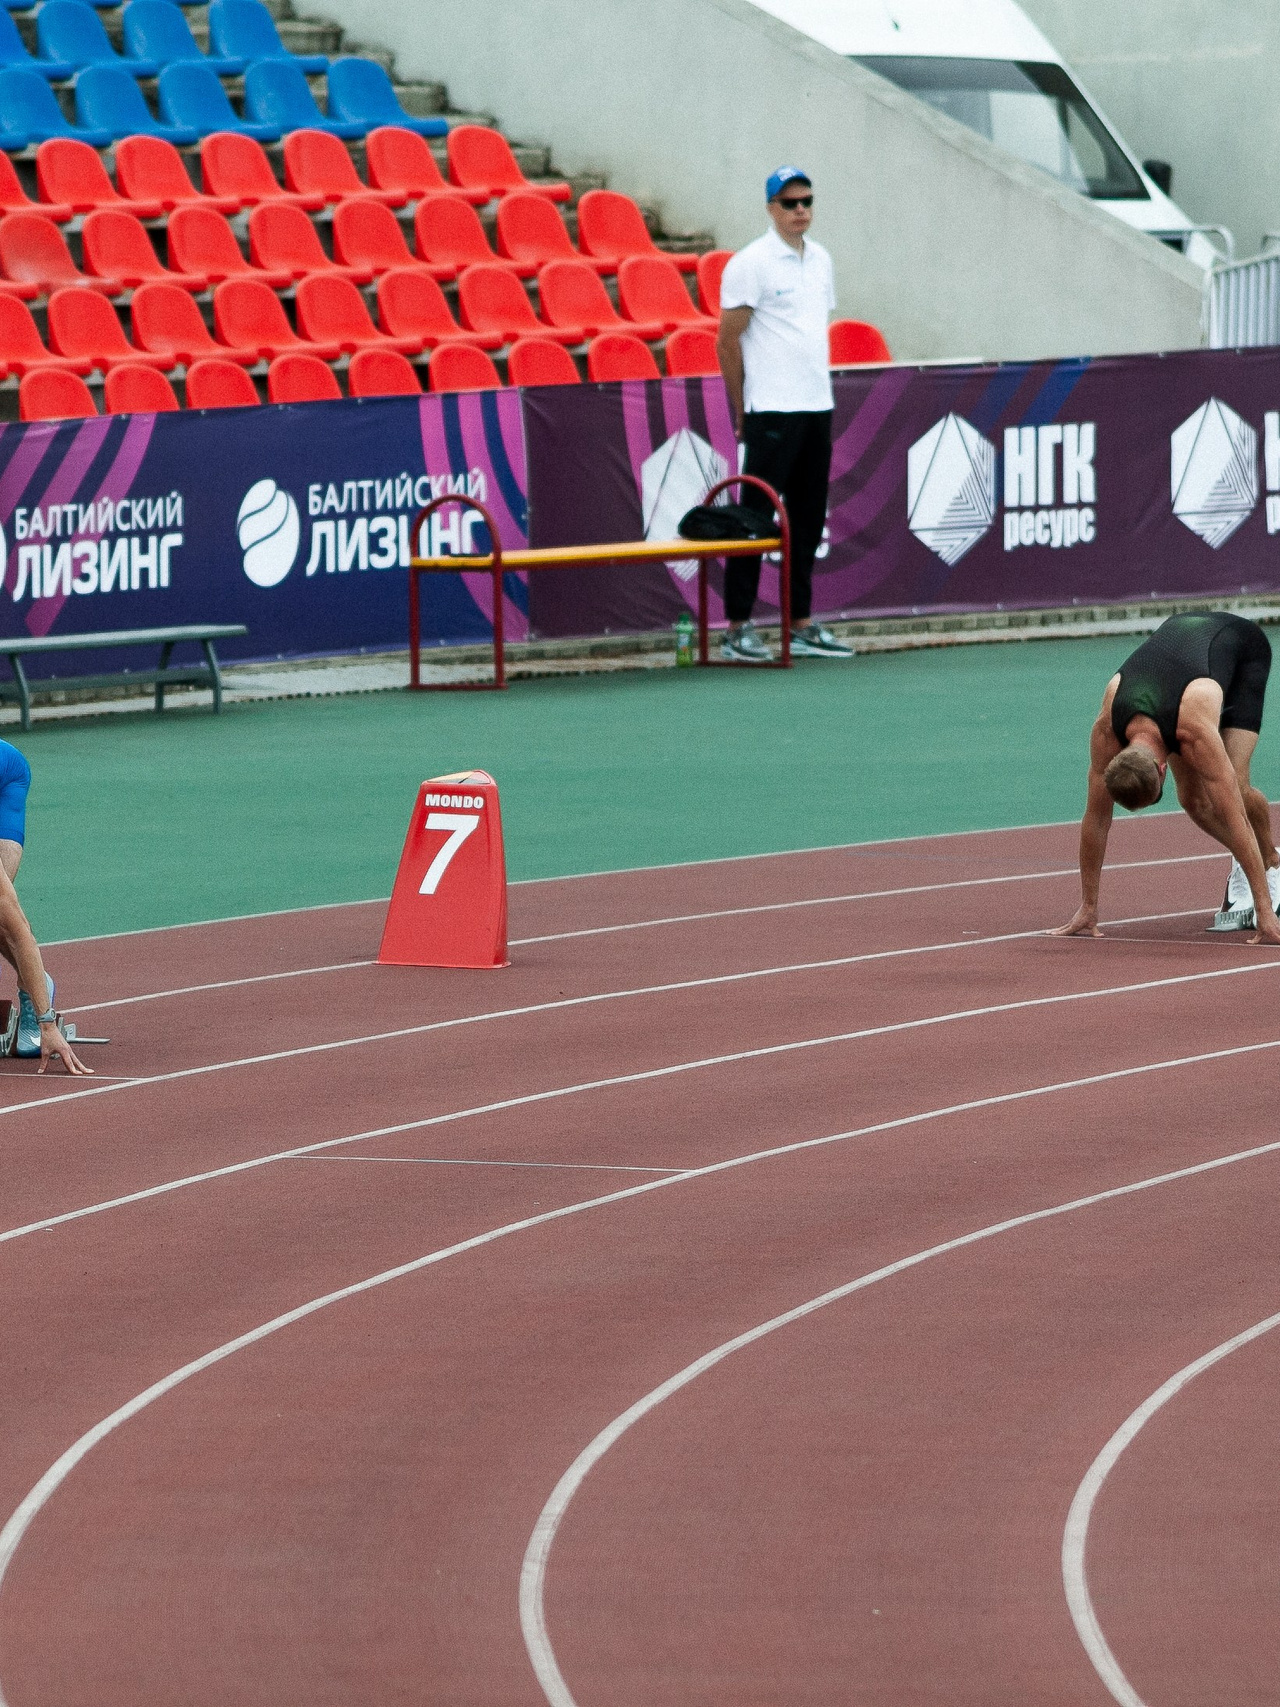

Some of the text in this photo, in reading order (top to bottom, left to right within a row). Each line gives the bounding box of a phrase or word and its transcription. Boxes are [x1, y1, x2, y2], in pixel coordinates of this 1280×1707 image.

[1003, 422, 1096, 508] НГК
[15, 491, 183, 540] БАЛТИЙСКИЙ
[309, 467, 487, 516] БАЛТИЙСКИЙ
[1003, 506, 1096, 551] ресурс
[13, 534, 183, 602] ЛИЗИНГ
[425, 793, 484, 809] MONDO
[418, 812, 480, 895] 7
